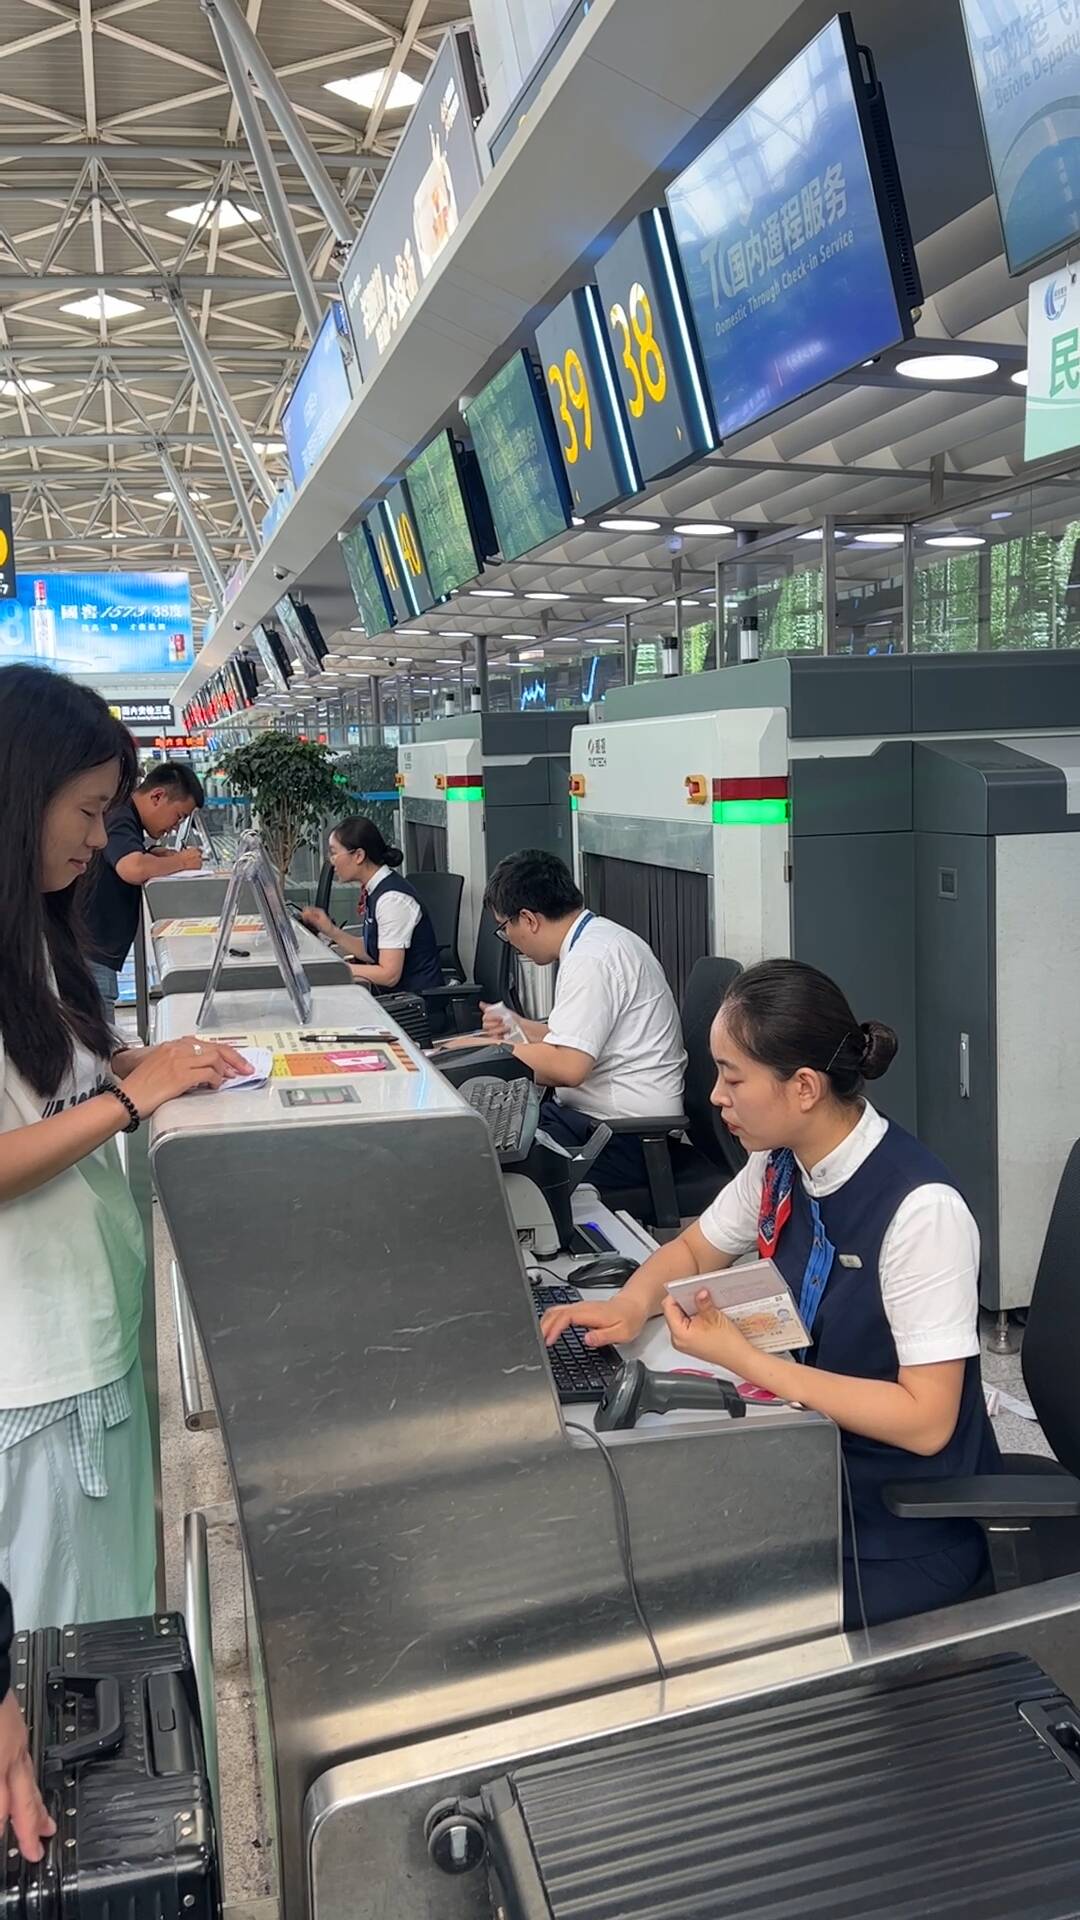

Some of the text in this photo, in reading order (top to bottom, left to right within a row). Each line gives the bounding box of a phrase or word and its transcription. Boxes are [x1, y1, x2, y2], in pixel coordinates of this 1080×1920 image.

[994, 71, 1032, 110] Before
[715, 229, 854, 337] Domestic Through Check-in Service
[727, 162, 848, 295] 国内通程服务
[548, 348, 592, 464] 39
[610, 281, 667, 419] 38
[397, 512, 422, 577] 40
